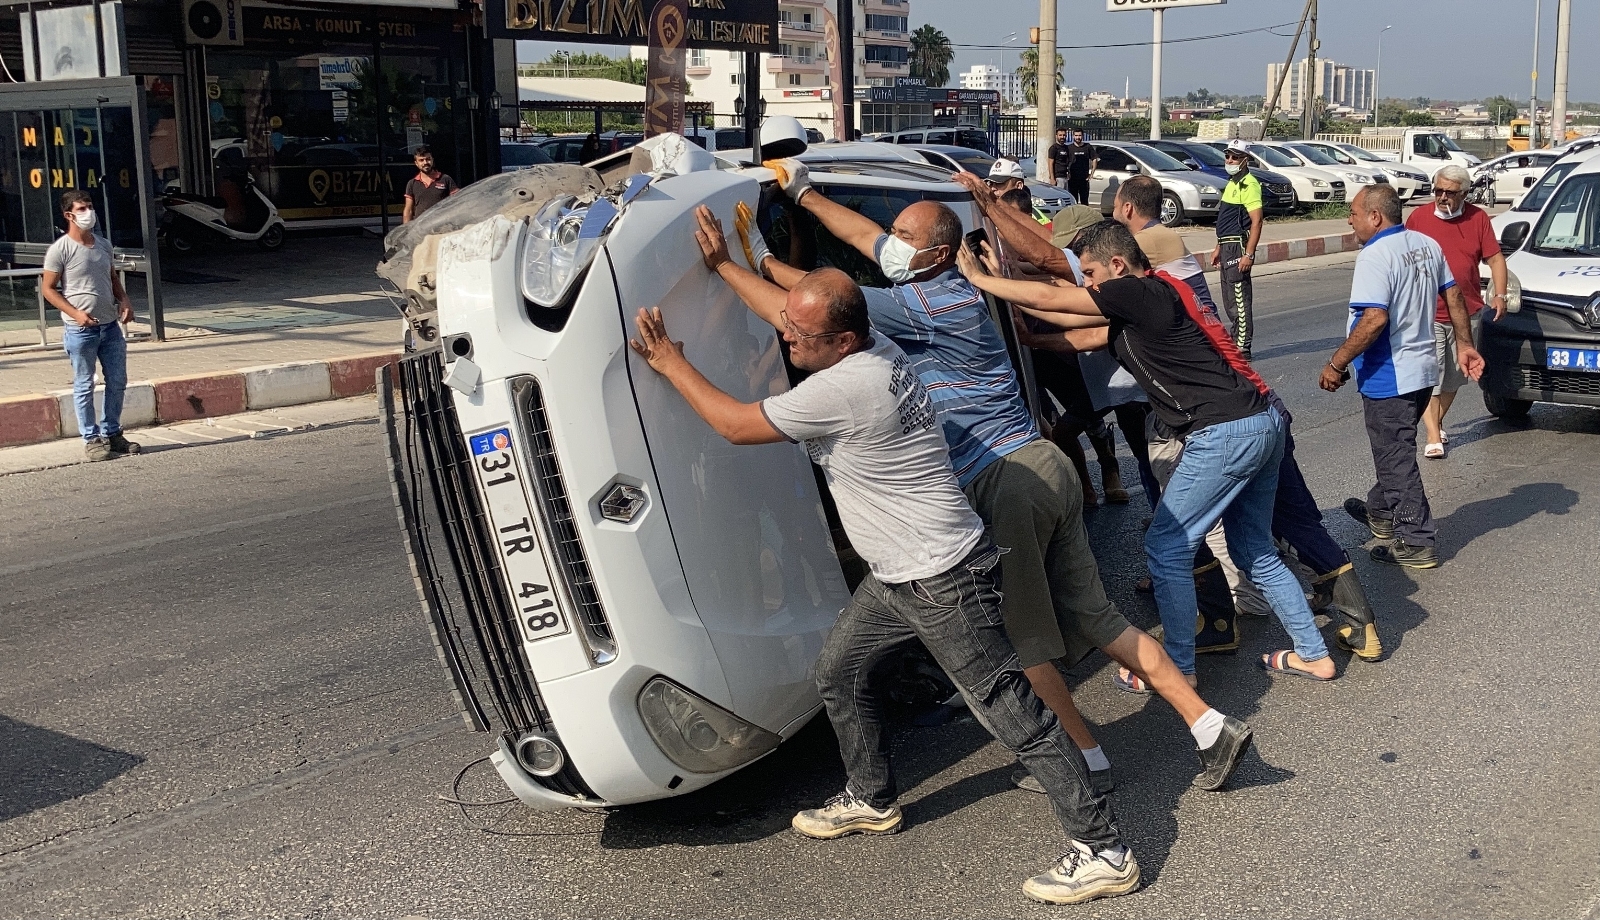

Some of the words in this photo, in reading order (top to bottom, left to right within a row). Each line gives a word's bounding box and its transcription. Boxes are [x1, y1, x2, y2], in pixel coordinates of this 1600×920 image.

[227, 0, 236, 40] BEKO
[262, 15, 302, 31] ARSA
[315, 18, 363, 34] KONUT
[711, 21, 770, 45] ESTATE
[1551, 350, 1570, 366] 33
[1576, 351, 1586, 367] A
[479, 437, 490, 452] TR
[481, 451, 516, 487] 31
[500, 516, 535, 557] TR
[519, 582, 559, 632] 418
